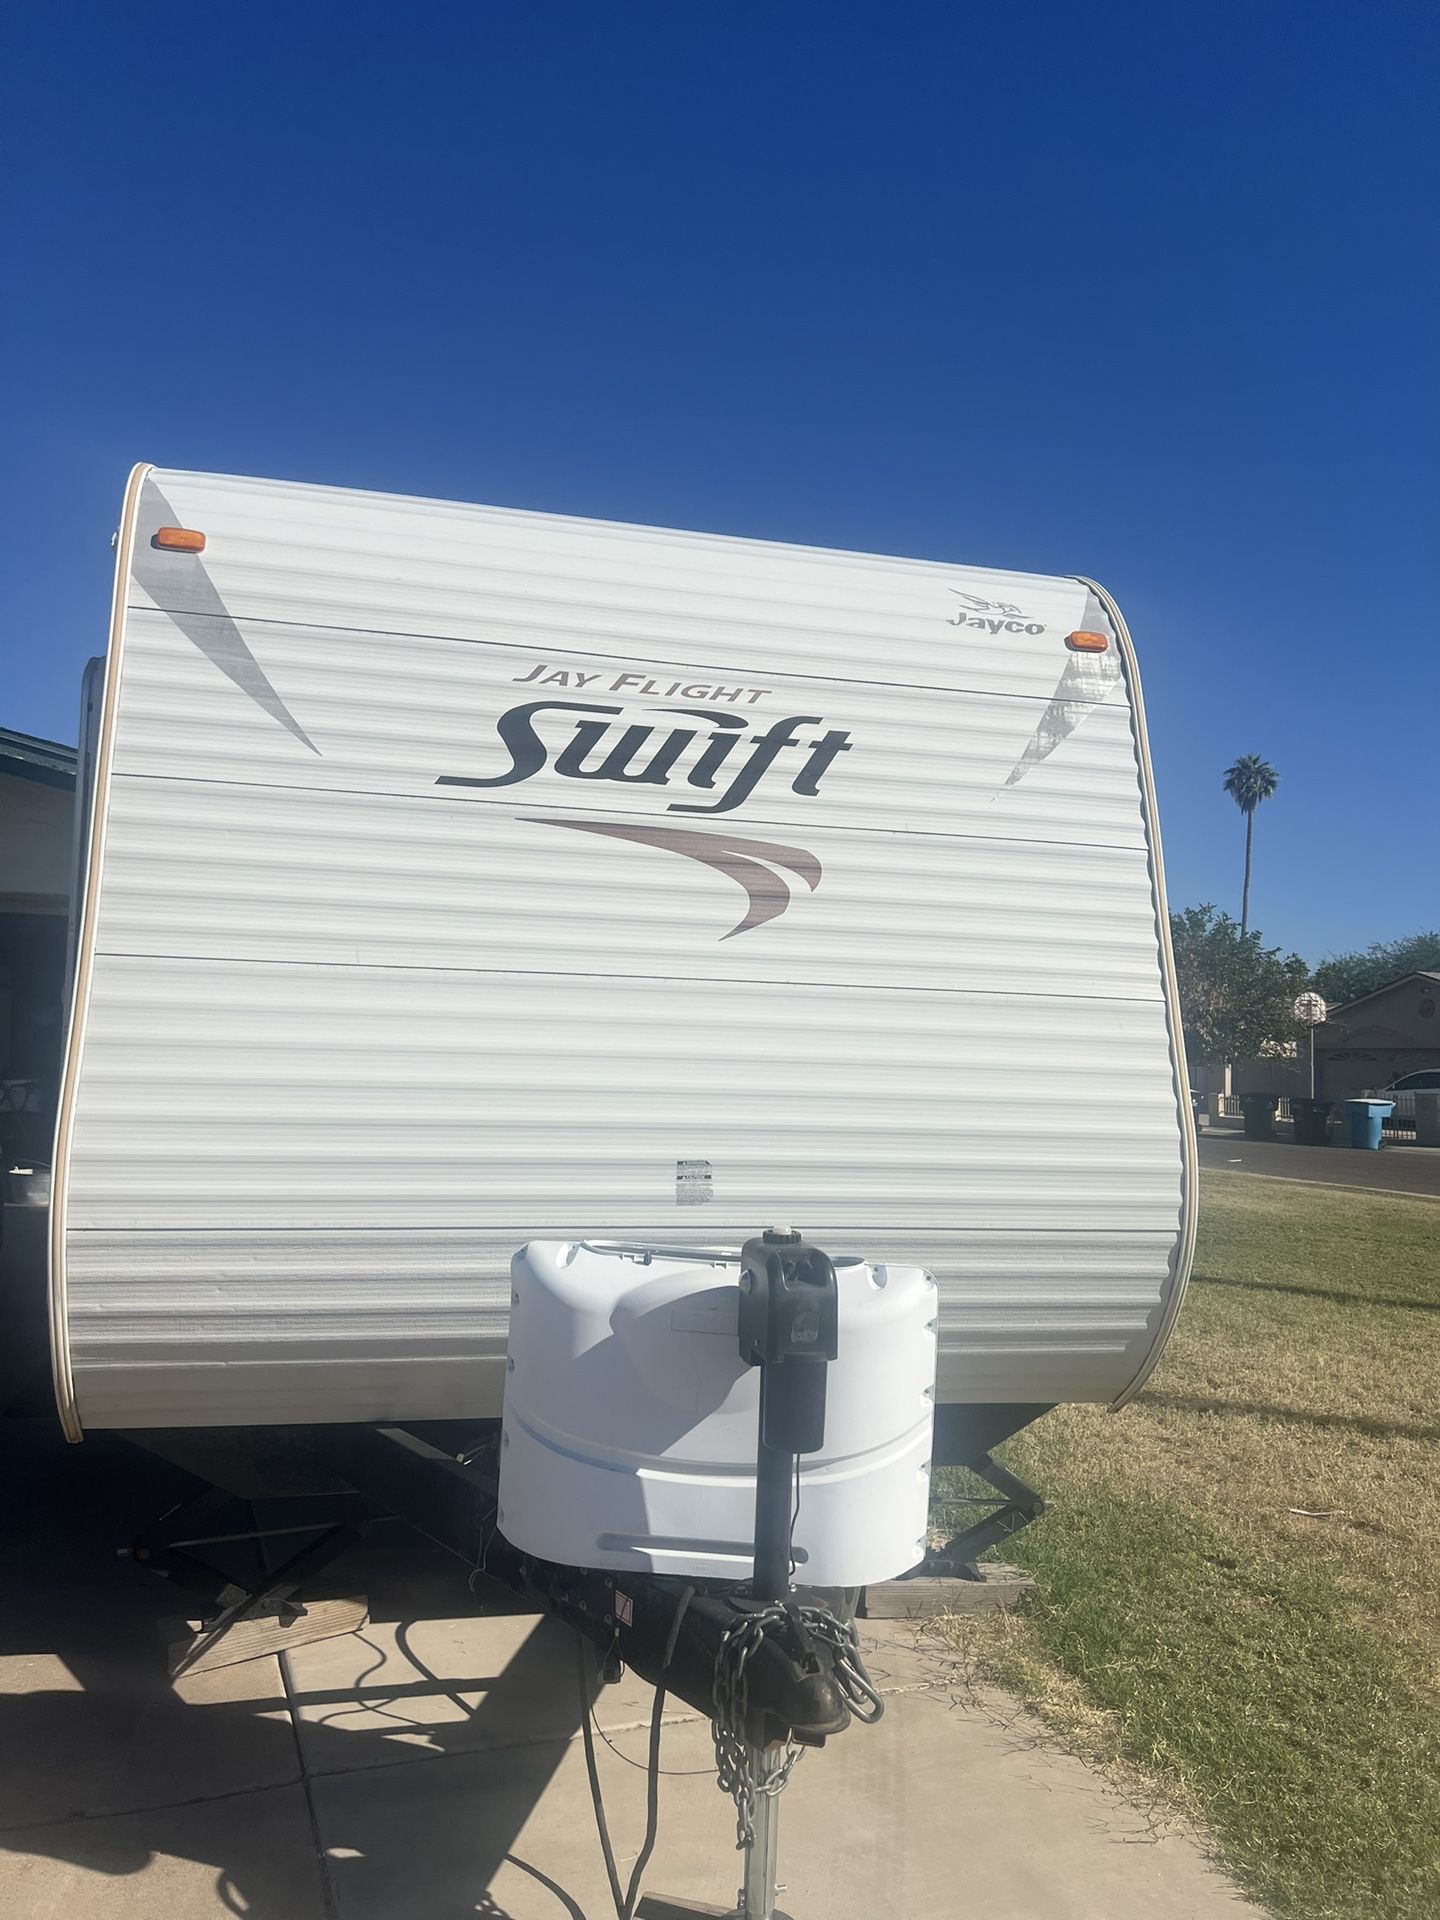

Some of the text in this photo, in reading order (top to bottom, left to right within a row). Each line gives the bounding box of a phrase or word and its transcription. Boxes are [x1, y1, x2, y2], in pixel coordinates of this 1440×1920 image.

[946, 612, 1045, 635] Jayco
[512, 664, 772, 704] JAY FLIGHT
[434, 700, 854, 814] Swift
